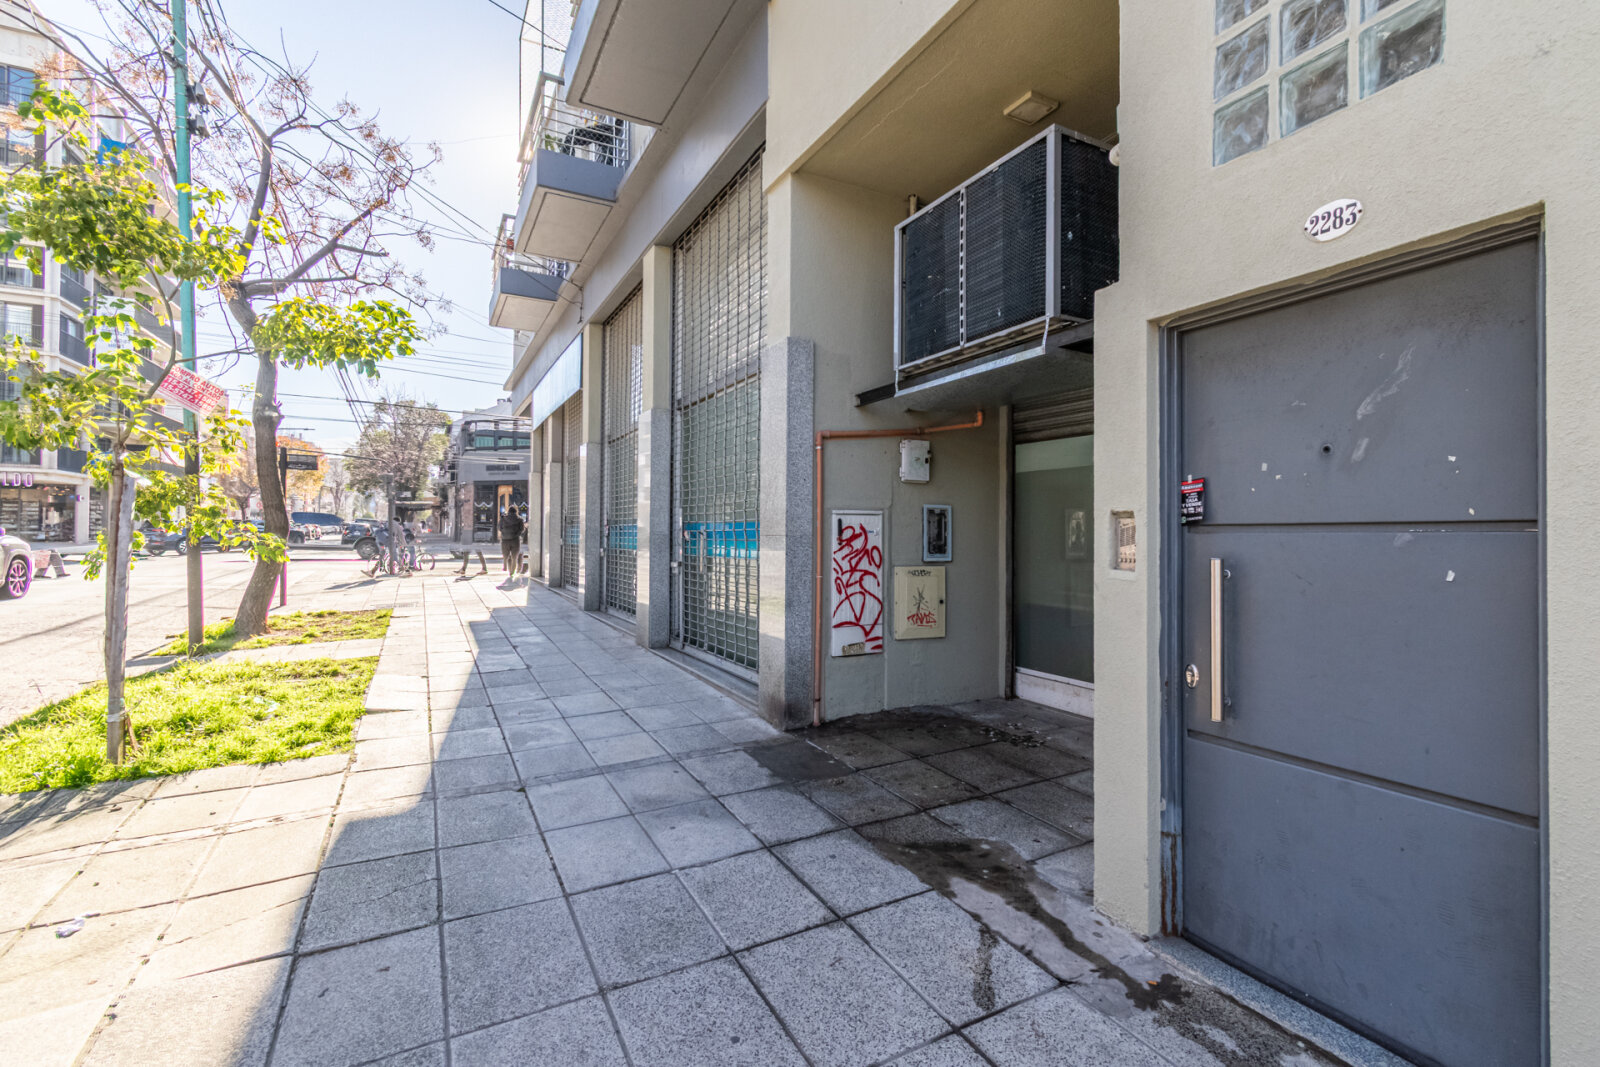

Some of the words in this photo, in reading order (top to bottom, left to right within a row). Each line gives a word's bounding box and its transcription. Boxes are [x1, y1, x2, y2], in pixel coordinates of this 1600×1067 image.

[1309, 201, 1358, 237] 2283
[192, 382, 221, 401] CONTADO
[201, 380, 225, 396] AUTOS
